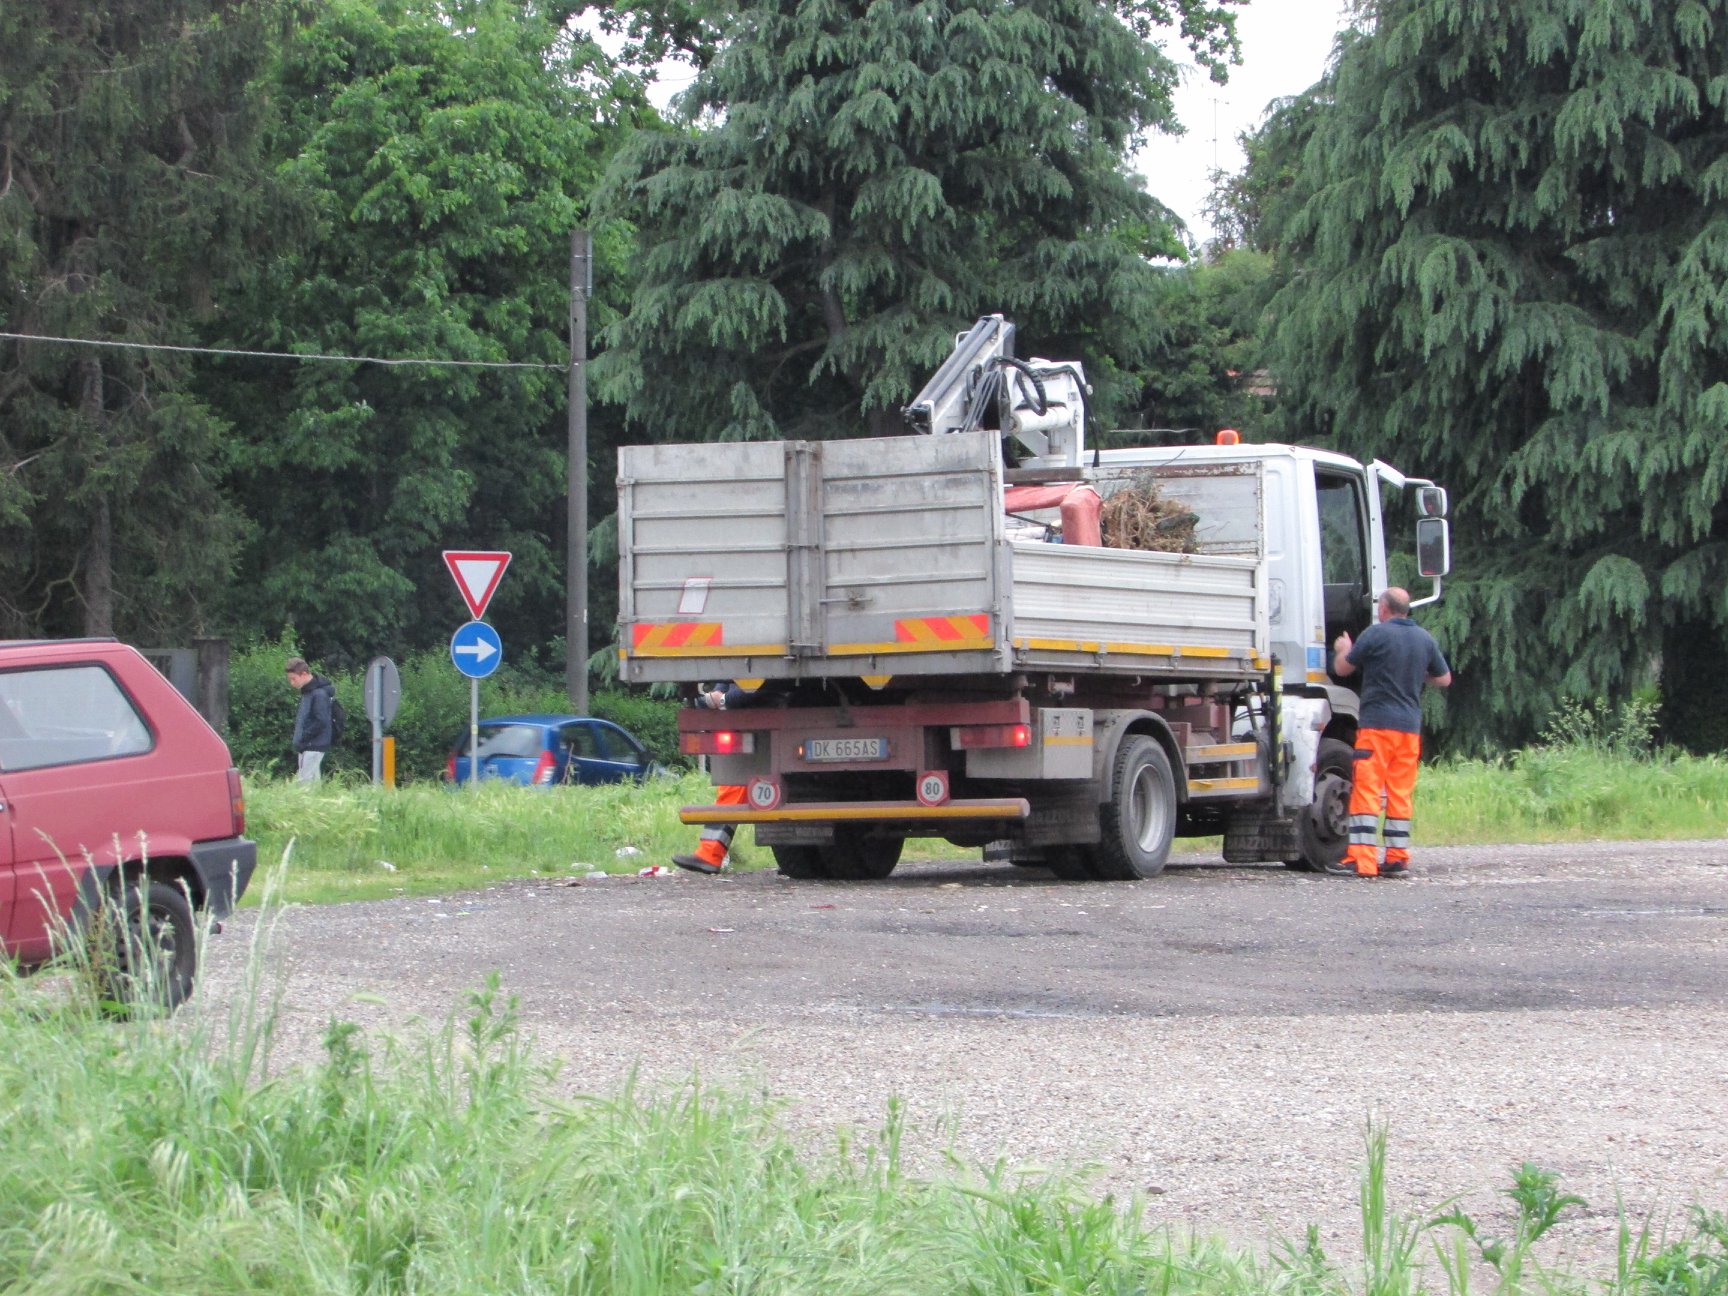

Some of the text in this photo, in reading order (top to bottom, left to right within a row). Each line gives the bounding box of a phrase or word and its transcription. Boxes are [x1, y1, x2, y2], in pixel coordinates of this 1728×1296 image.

[814, 741, 878, 757] DK 665AS
[758, 786, 771, 800] 70
[925, 782, 940, 796] 80
